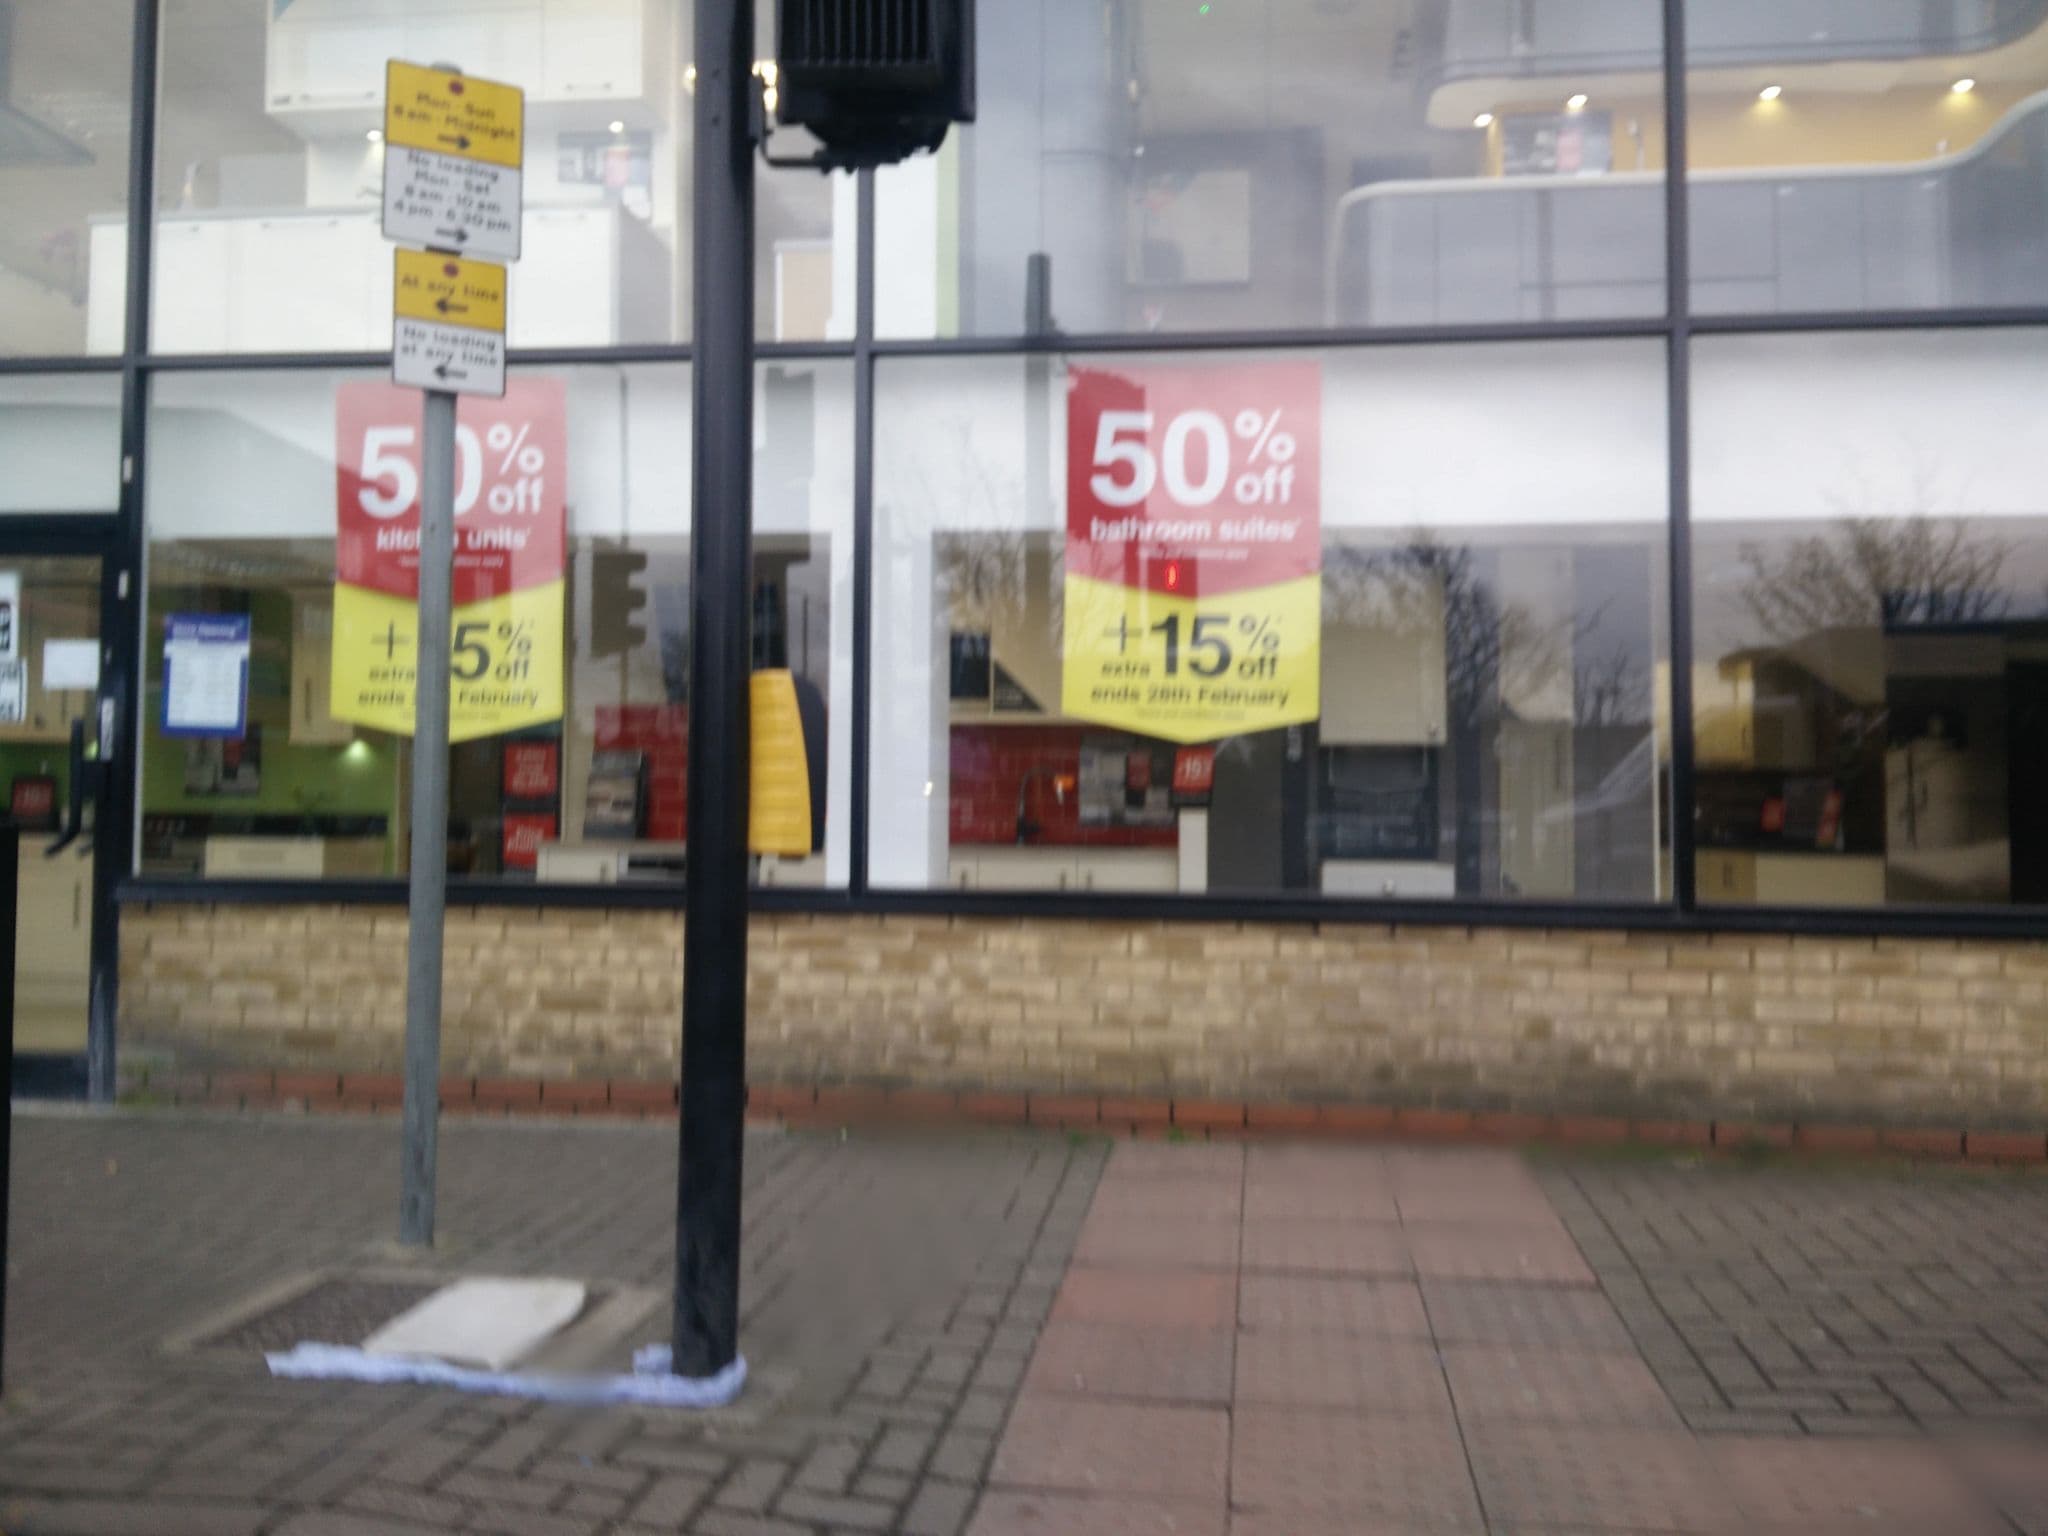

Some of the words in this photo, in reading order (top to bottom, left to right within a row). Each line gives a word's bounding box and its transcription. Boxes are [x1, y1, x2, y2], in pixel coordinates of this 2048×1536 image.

[445, 115, 516, 141] Midnight
[438, 158, 499, 183] loading
[427, 281, 456, 297] any
[464, 283, 499, 303] time
[403, 325, 427, 340] No
[433, 328, 496, 352] loading
[425, 348, 454, 362] any
[462, 352, 498, 368] time
[487, 476, 544, 516] off
[1234, 463, 1296, 505] off
[376, 527, 459, 552] kitc
[1090, 515, 1212, 543] bathroom
[495, 656, 532, 683] off
[1101, 660, 1151, 678] extra
[1237, 654, 1280, 681] off
[458, 688, 540, 709] February
[1090, 684, 1141, 704] ends
[1197, 684, 1290, 710] February
